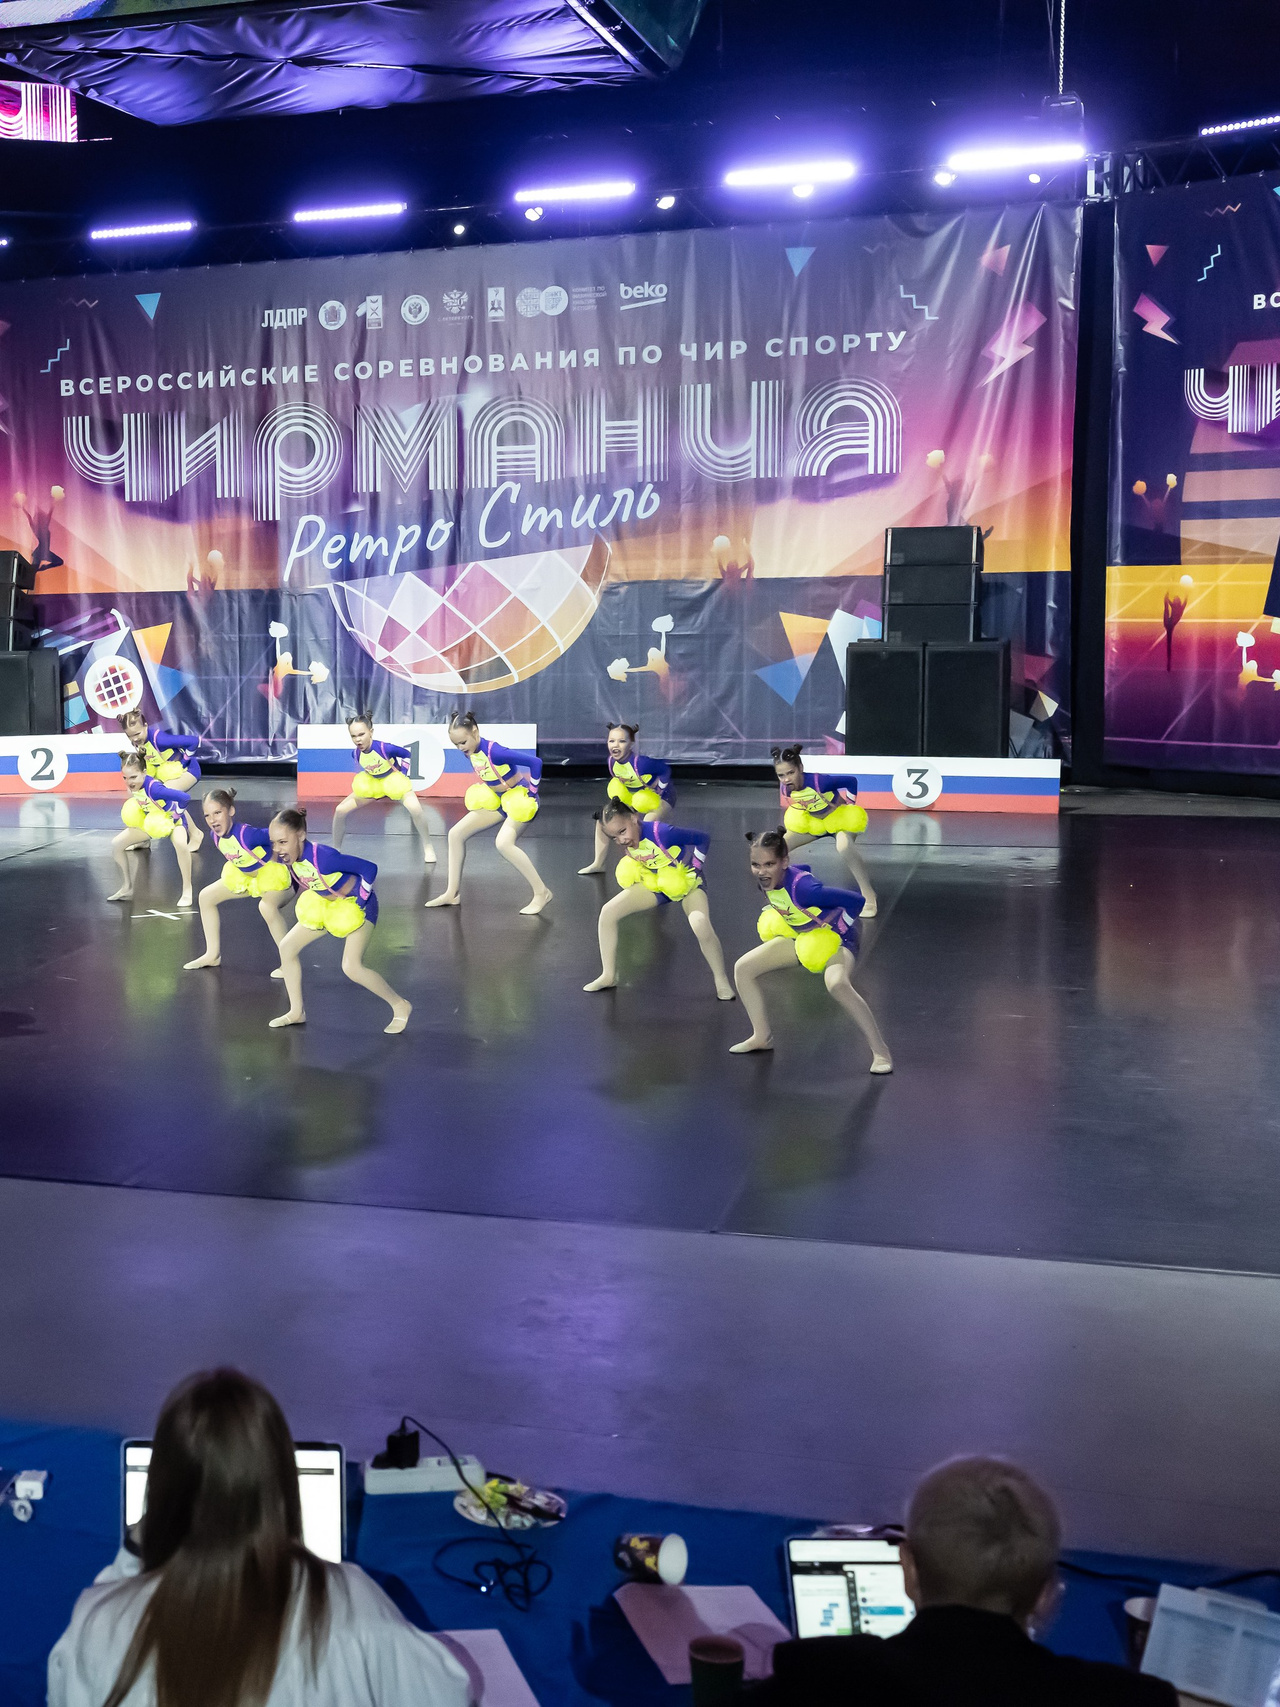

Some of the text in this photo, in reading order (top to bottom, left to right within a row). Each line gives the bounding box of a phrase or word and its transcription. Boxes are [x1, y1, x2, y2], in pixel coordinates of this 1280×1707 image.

[620, 281, 668, 299] beko
[261, 307, 308, 330] ЛДПР
[60, 331, 907, 397] ВСЕРОССИЙСКИЕ СОРЕВНОВАНИЯ ПО ЧИР СПОРТУ
[283, 481, 661, 582] Ретро Стиль
[30, 747, 55, 781] 2
[404, 740, 426, 780] 1
[905, 768, 930, 799] 3
